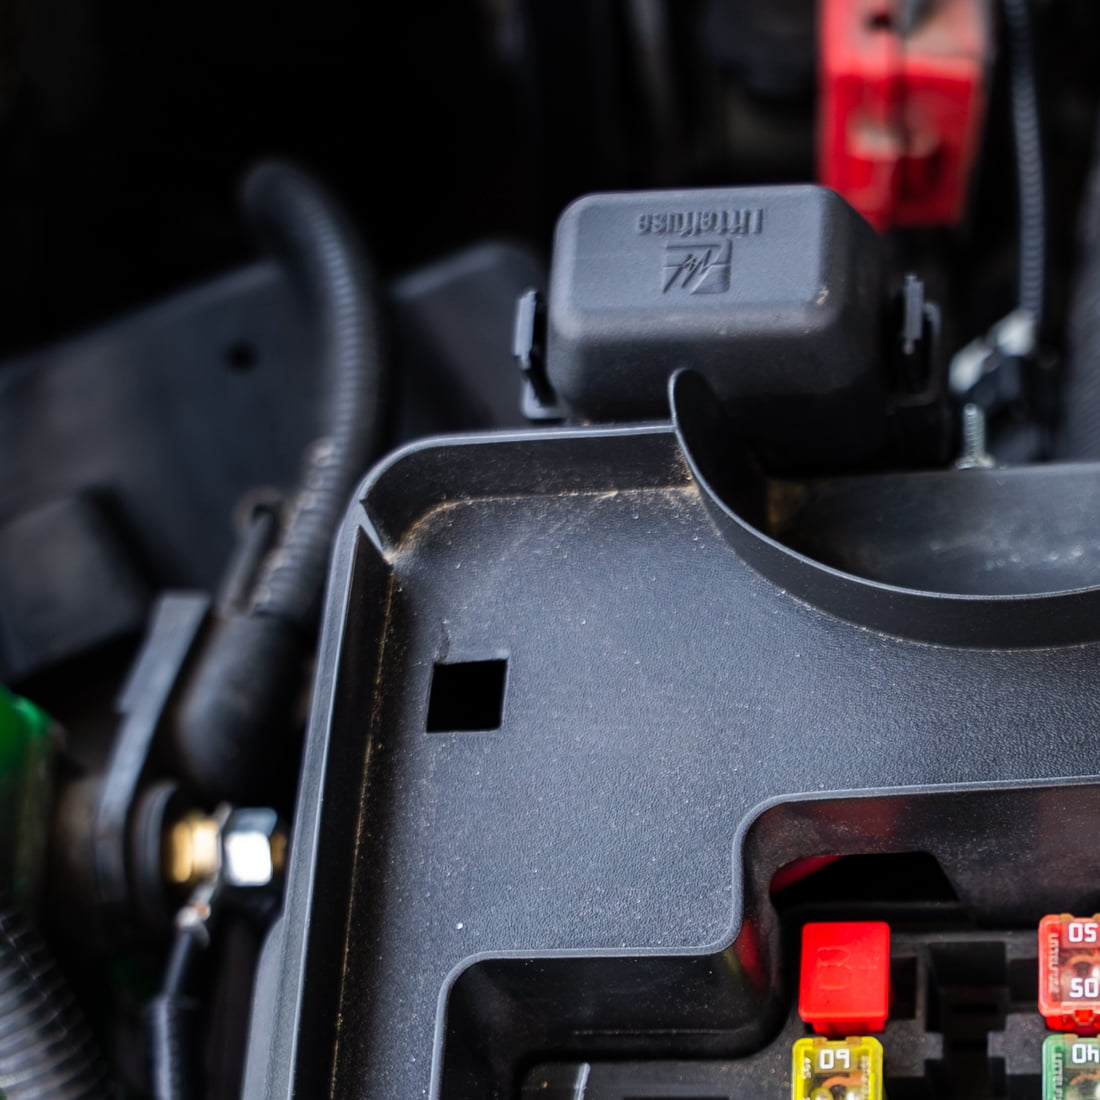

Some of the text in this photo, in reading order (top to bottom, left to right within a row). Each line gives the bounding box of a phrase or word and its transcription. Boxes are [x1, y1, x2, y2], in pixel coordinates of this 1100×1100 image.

[1068, 922, 1099, 943] 50
[1069, 977, 1099, 998] 50
[819, 1048, 850, 1069] 60
[1072, 1043, 1100, 1064] 40
